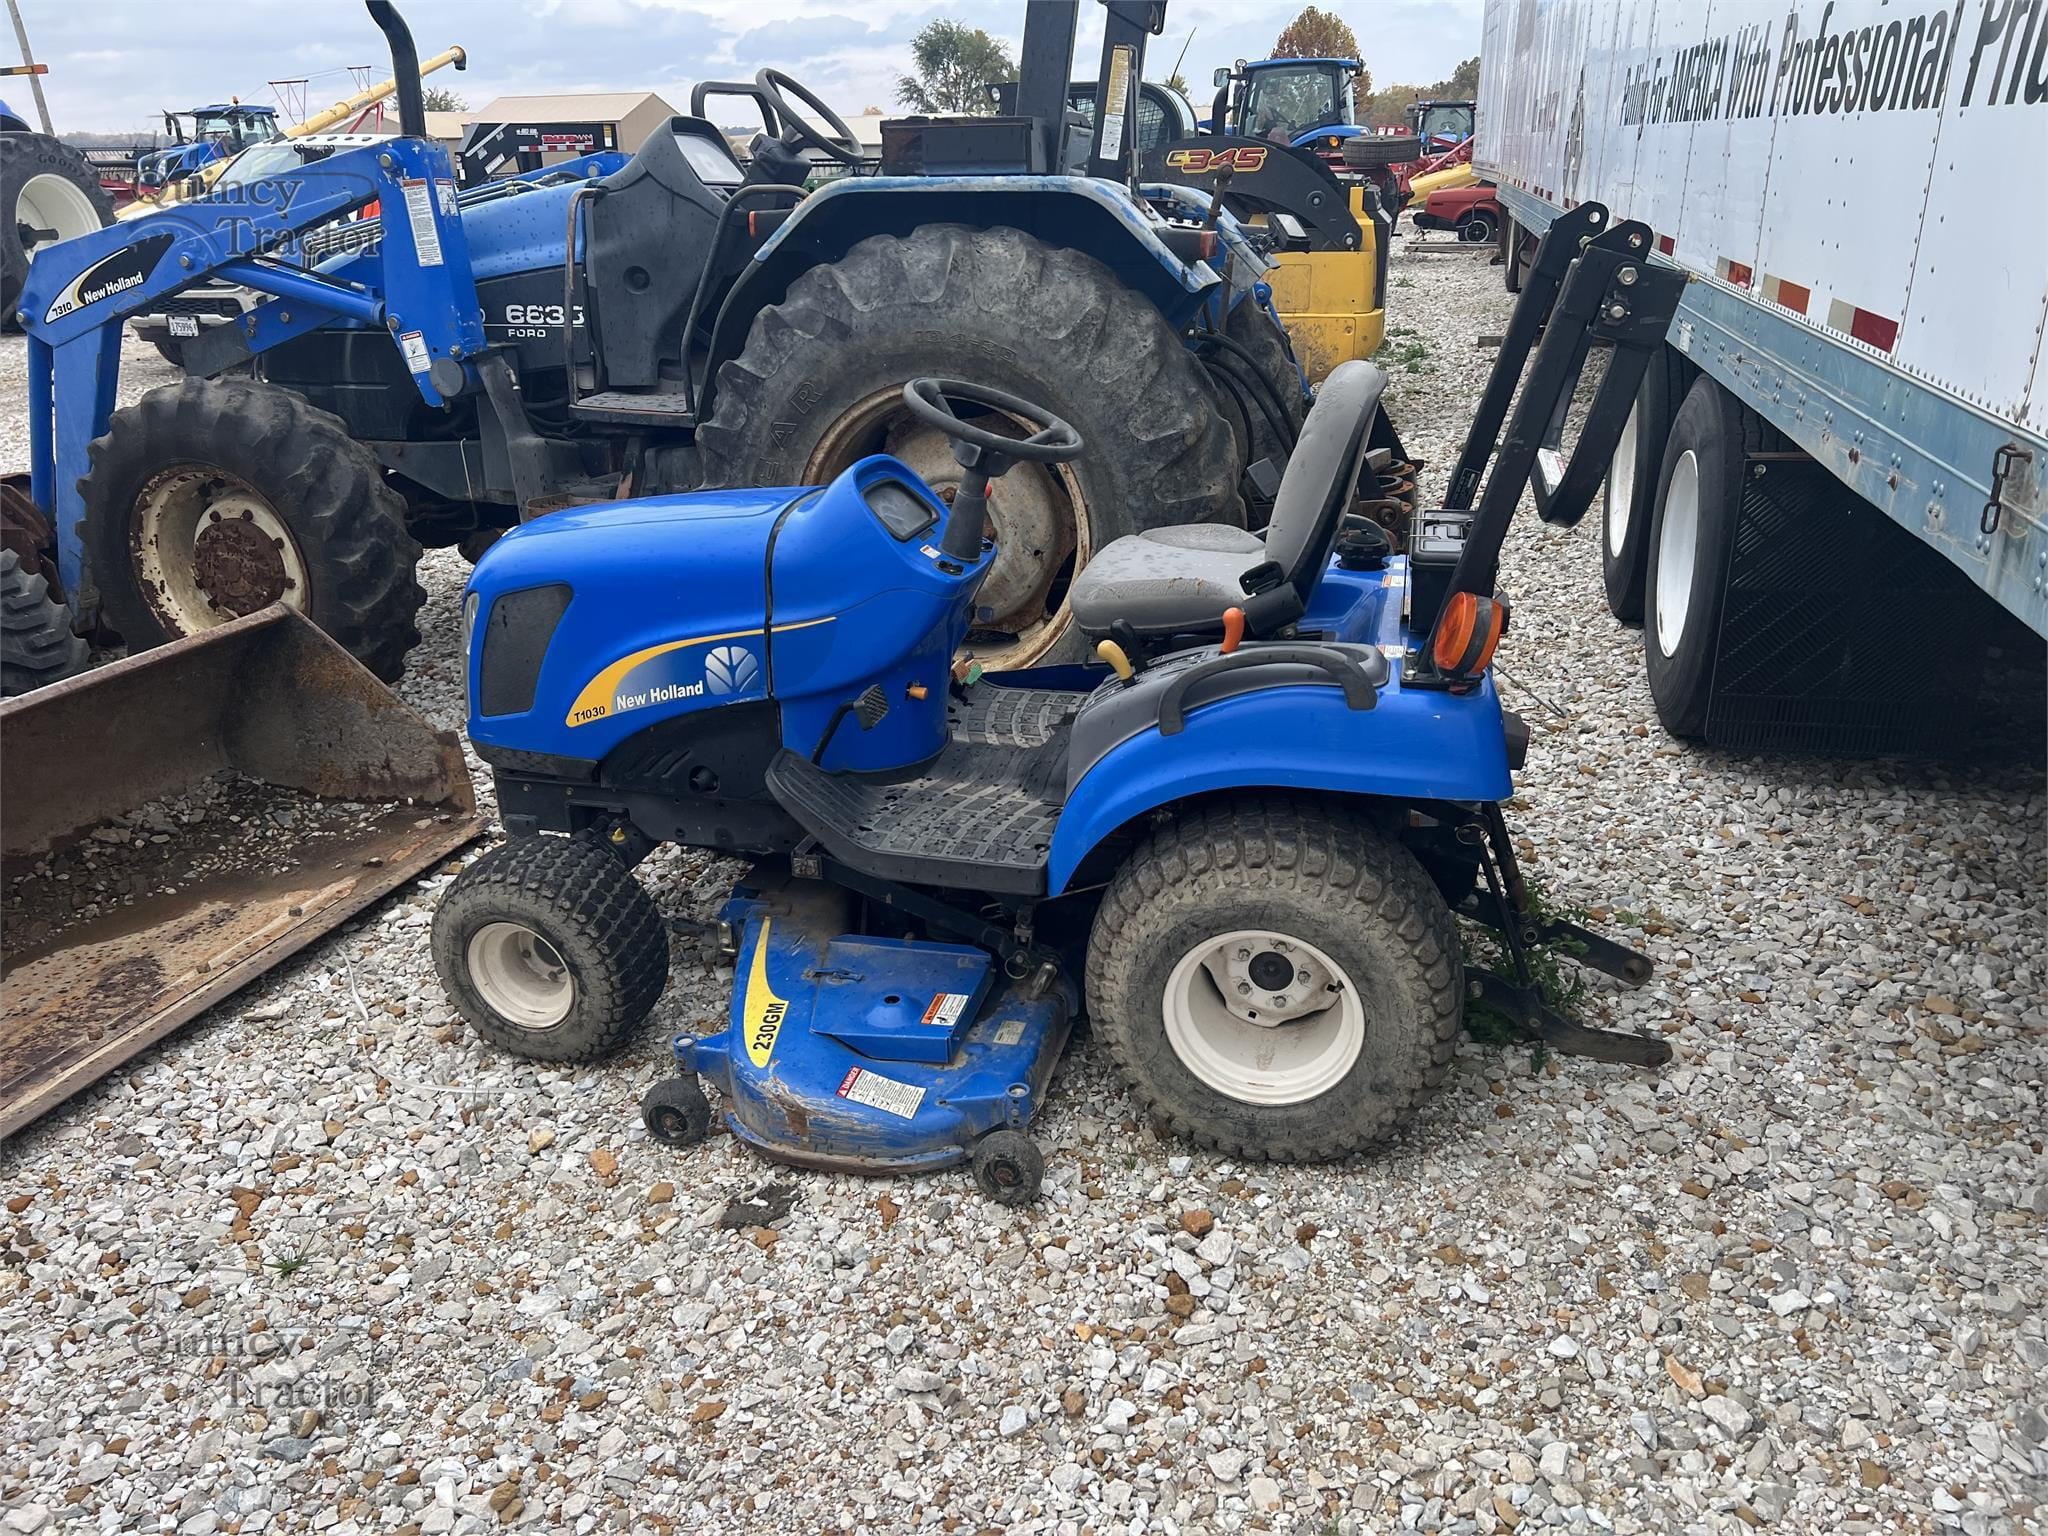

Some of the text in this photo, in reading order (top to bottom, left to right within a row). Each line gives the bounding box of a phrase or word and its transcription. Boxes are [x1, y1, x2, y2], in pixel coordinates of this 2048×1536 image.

[1647, 57, 1668, 125] For
[1663, 34, 1729, 123] AMERICA
[1725, 19, 1772, 119] With
[1768, 0, 1965, 117] Professional
[1166, 148, 1268, 173] C345
[84, 271, 143, 305] New Holland
[52, 301, 72, 316] 7310
[507, 328, 546, 338] FORD
[616, 680, 704, 711] New Holland
[573, 705, 606, 723] T1030
[752, 1003, 786, 1050] 230GM
